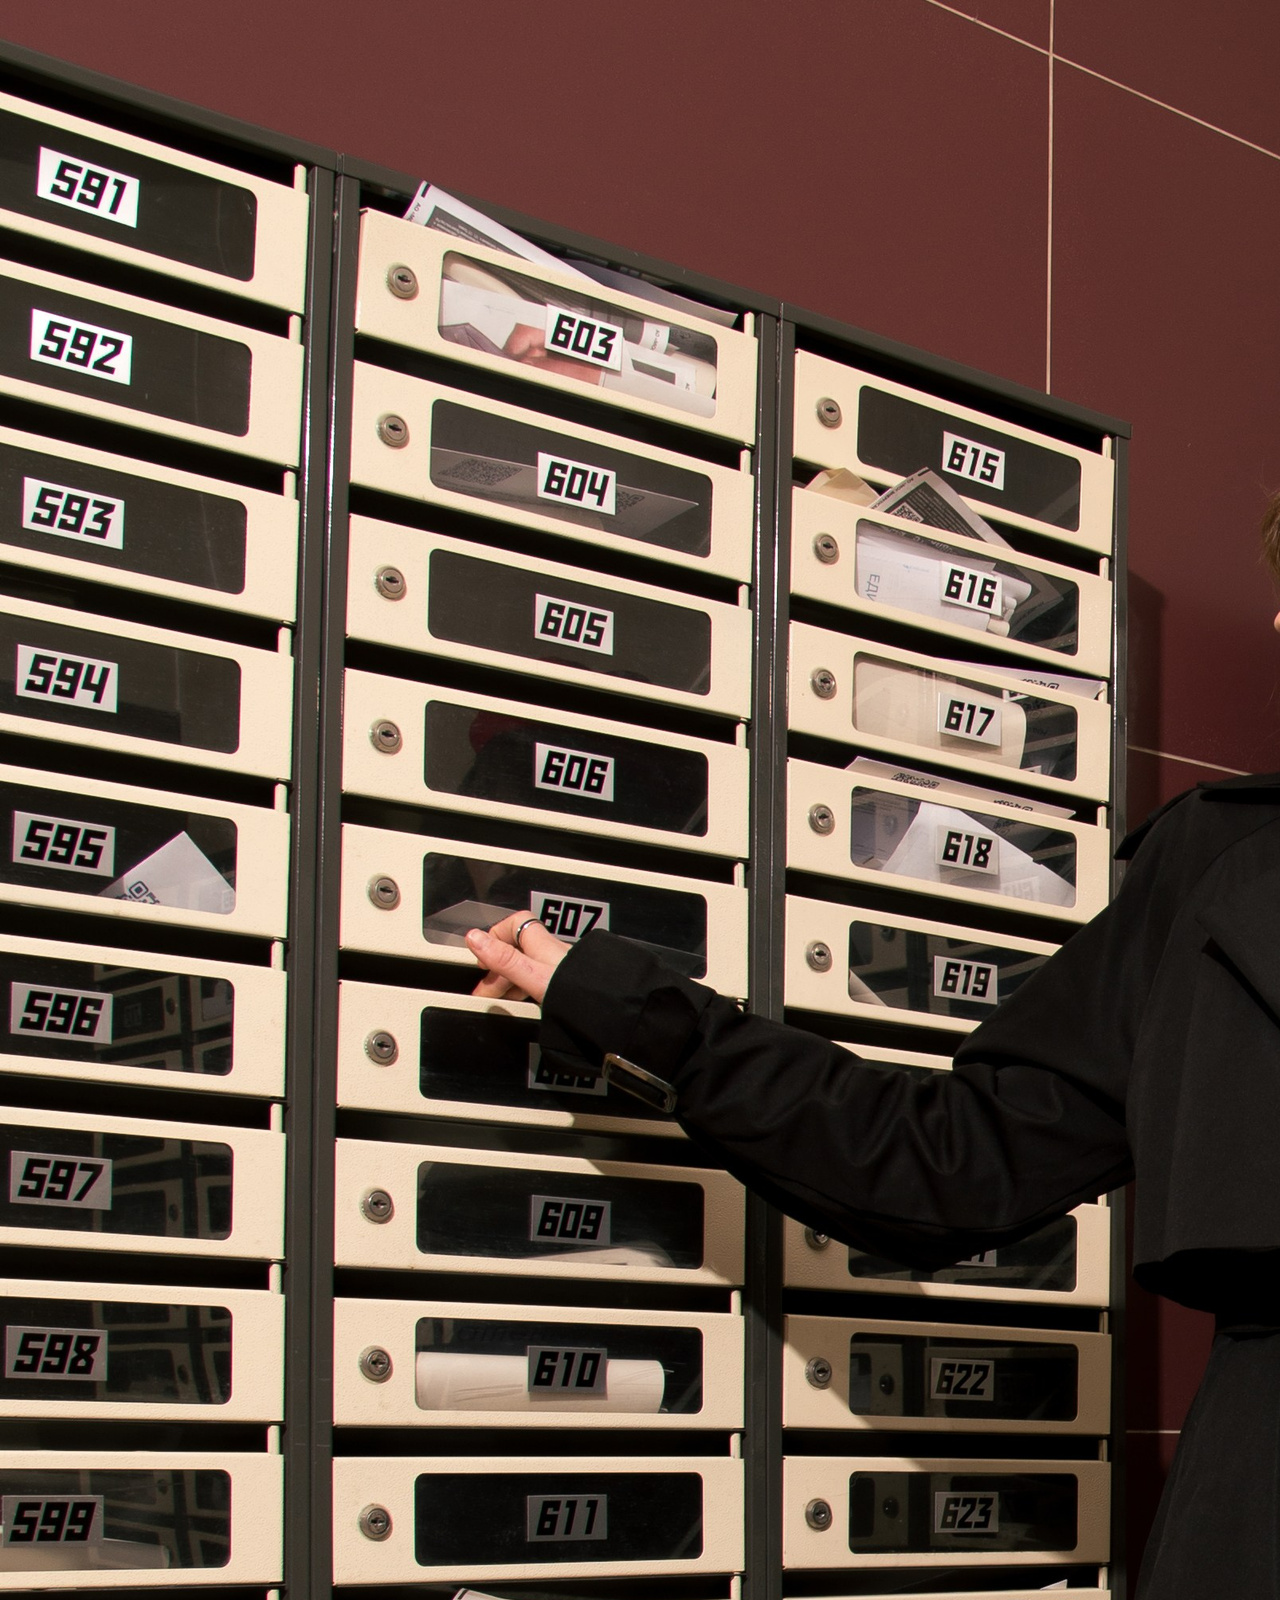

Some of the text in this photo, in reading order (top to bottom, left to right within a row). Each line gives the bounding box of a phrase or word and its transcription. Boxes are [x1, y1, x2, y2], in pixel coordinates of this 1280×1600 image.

[50, 160, 127, 215] 591
[39, 320, 124, 375] 592
[550, 313, 617, 362] 603
[947, 441, 1000, 483] 615
[543, 461, 610, 507] 604
[31, 487, 116, 539] 593
[945, 568, 997, 609] 616
[540, 602, 608, 647] 605
[25, 654, 110, 704] 594
[945, 700, 995, 736] 617
[541, 750, 609, 794] 606
[20, 820, 107, 869] 595
[942, 831, 993, 868] 618
[540, 898, 603, 939] 607
[941, 961, 991, 998] 619
[19, 990, 104, 1037] 596
[18, 1158, 104, 1201] 597
[537, 1201, 604, 1240] 609
[13, 1333, 100, 1375] 598
[533, 1351, 601, 1387] 610
[936, 1363, 990, 1396] 622
[9, 1502, 96, 1542] 599
[536, 1500, 598, 1536] 611
[940, 1497, 994, 1529] 623
